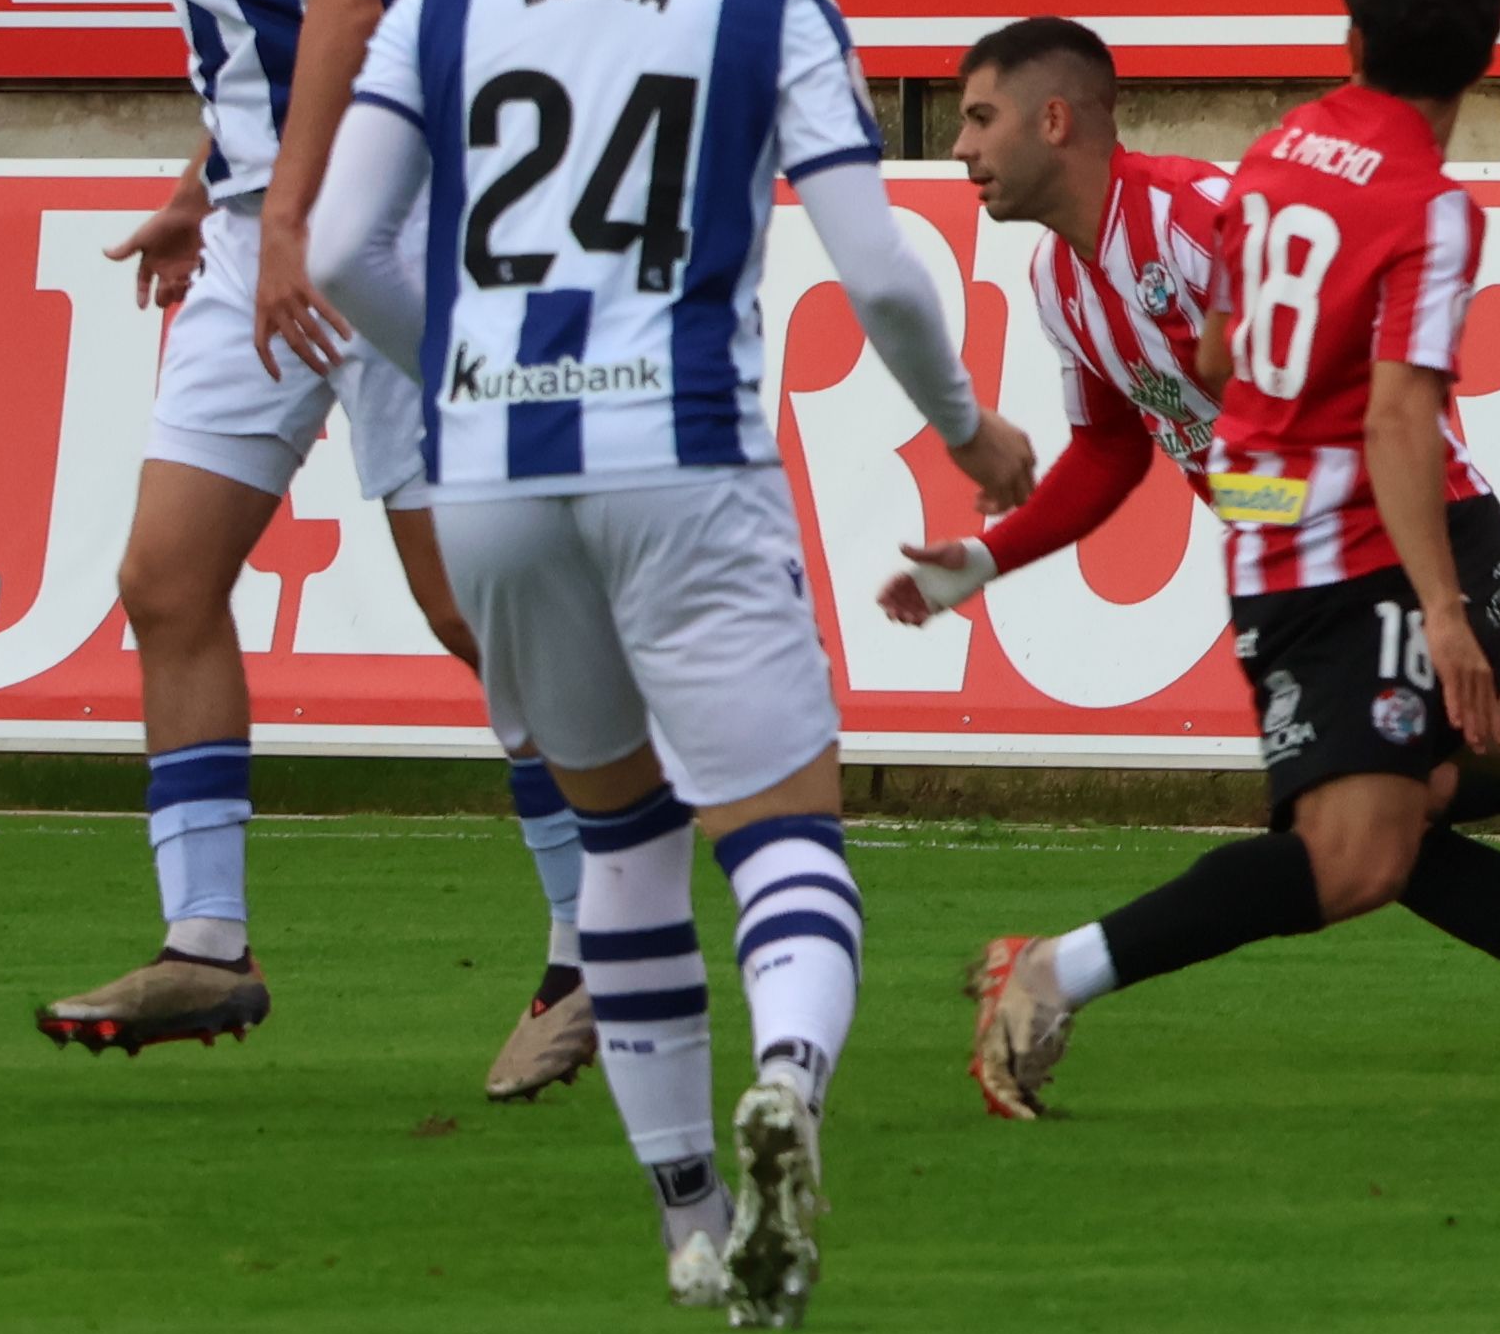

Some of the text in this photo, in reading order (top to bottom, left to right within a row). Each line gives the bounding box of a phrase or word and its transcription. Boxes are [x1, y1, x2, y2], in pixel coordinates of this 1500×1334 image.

[463, 73, 699, 293] 24
[448, 343, 663, 404] Kutxabank
[1230, 191, 1341, 401] 18
